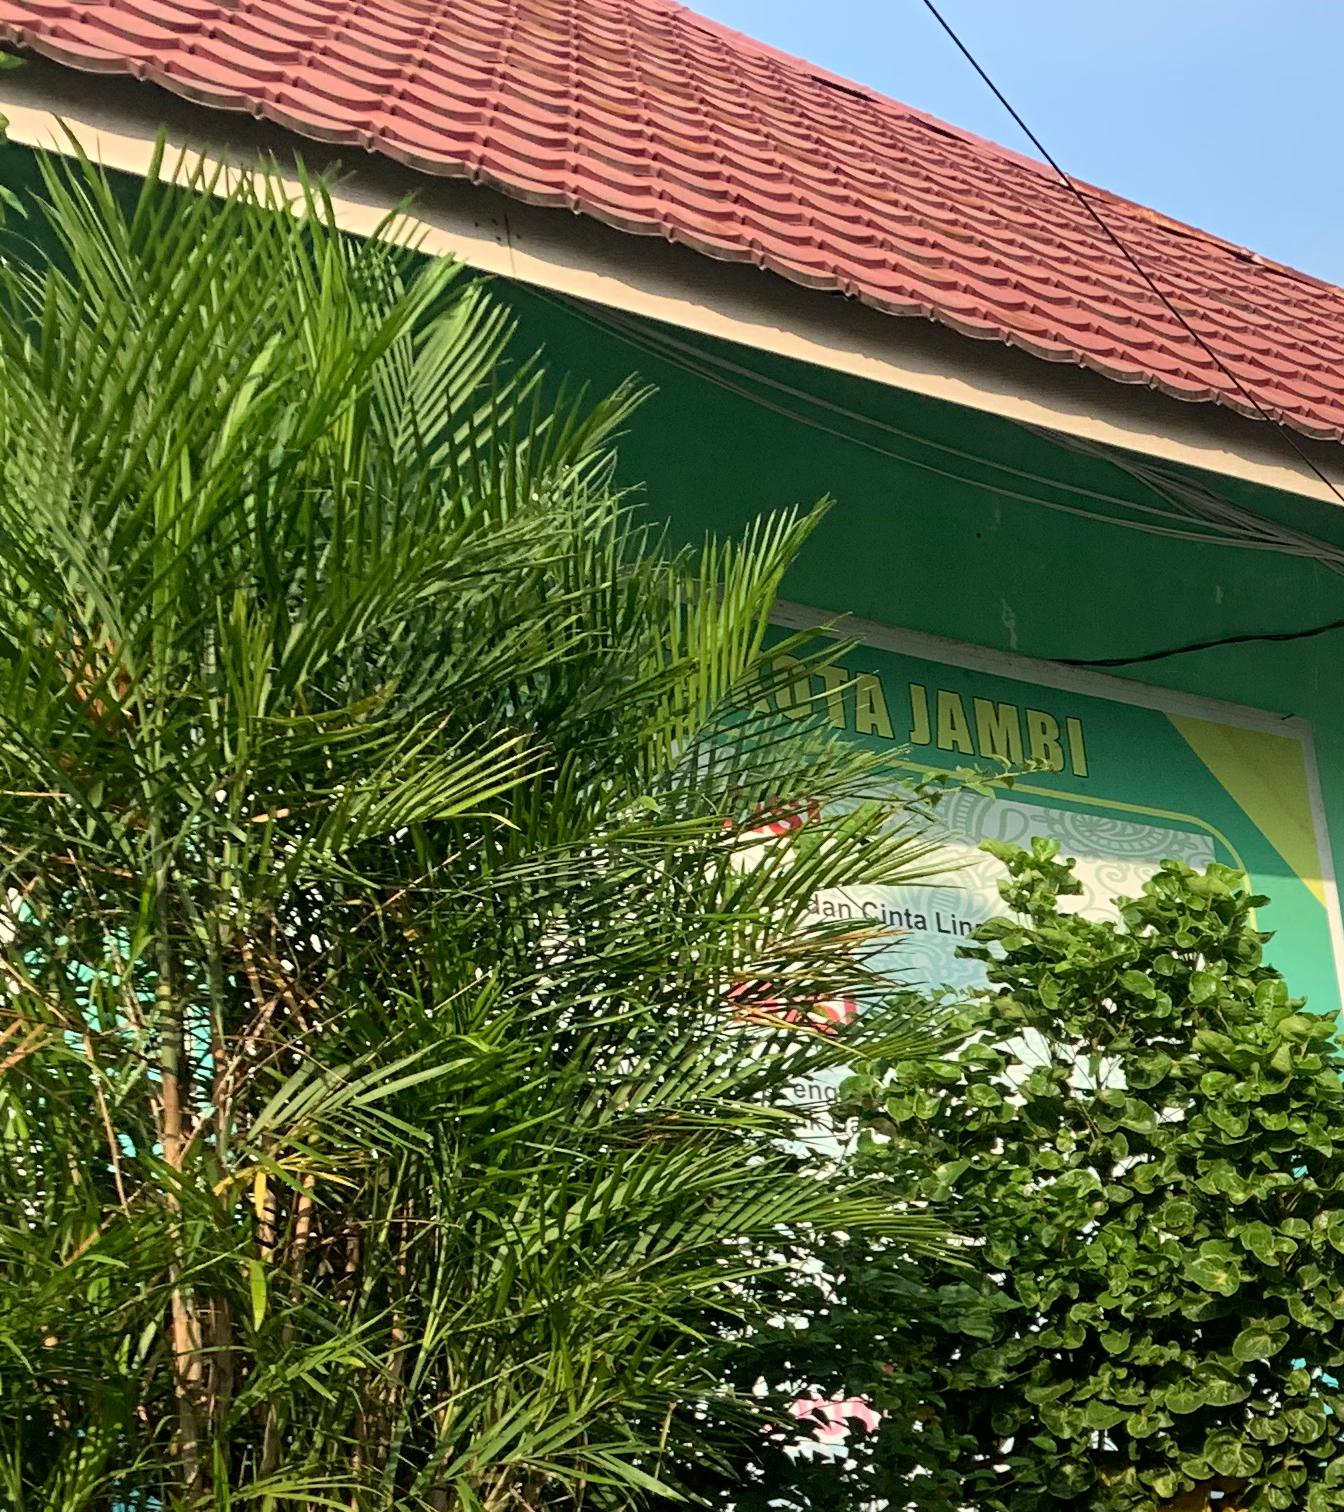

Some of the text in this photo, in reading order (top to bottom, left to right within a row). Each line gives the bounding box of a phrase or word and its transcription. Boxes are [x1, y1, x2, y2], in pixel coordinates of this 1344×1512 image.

[908, 682, 1090, 779] JAMBI
[808, 893, 851, 918] dan
[862, 901, 928, 932] Cinta
